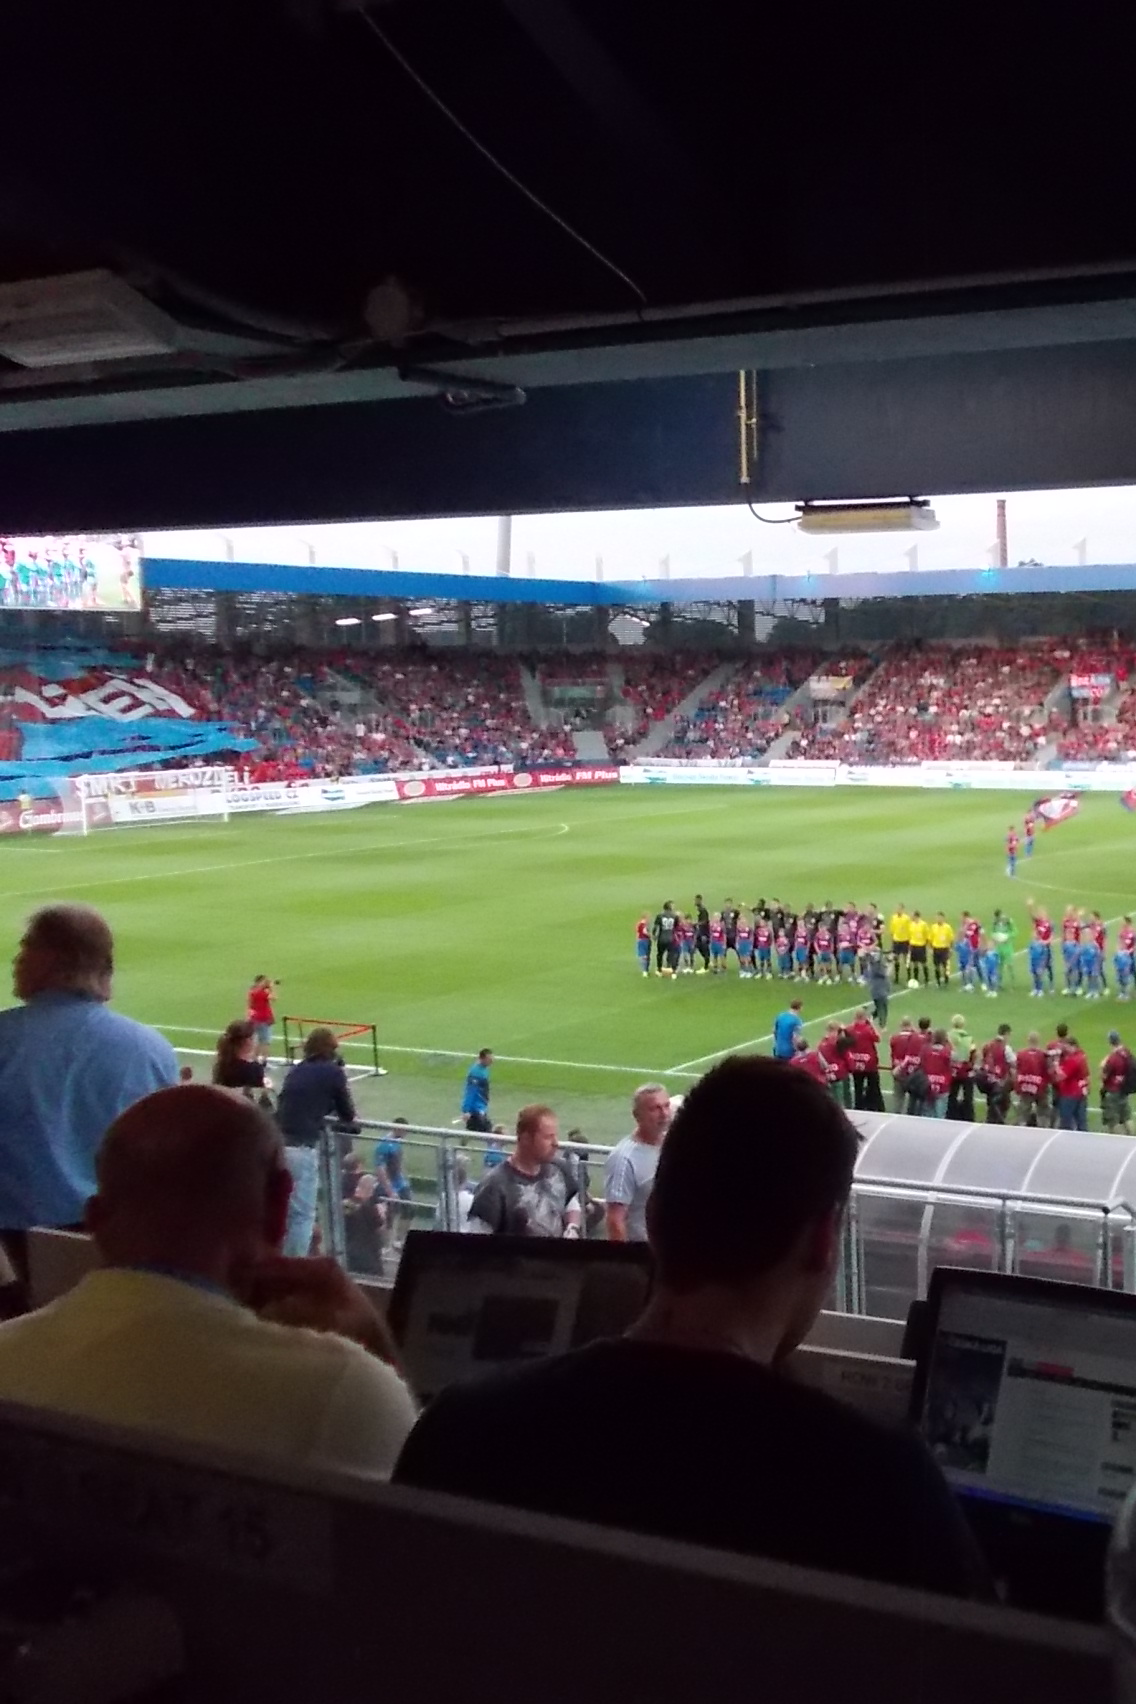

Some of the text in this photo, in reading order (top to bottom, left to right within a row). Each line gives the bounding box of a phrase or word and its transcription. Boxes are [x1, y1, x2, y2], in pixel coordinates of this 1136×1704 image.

[576, 770, 592, 780] FM
[595, 770, 618, 779] Plus
[487, 778, 506, 787] Plus
